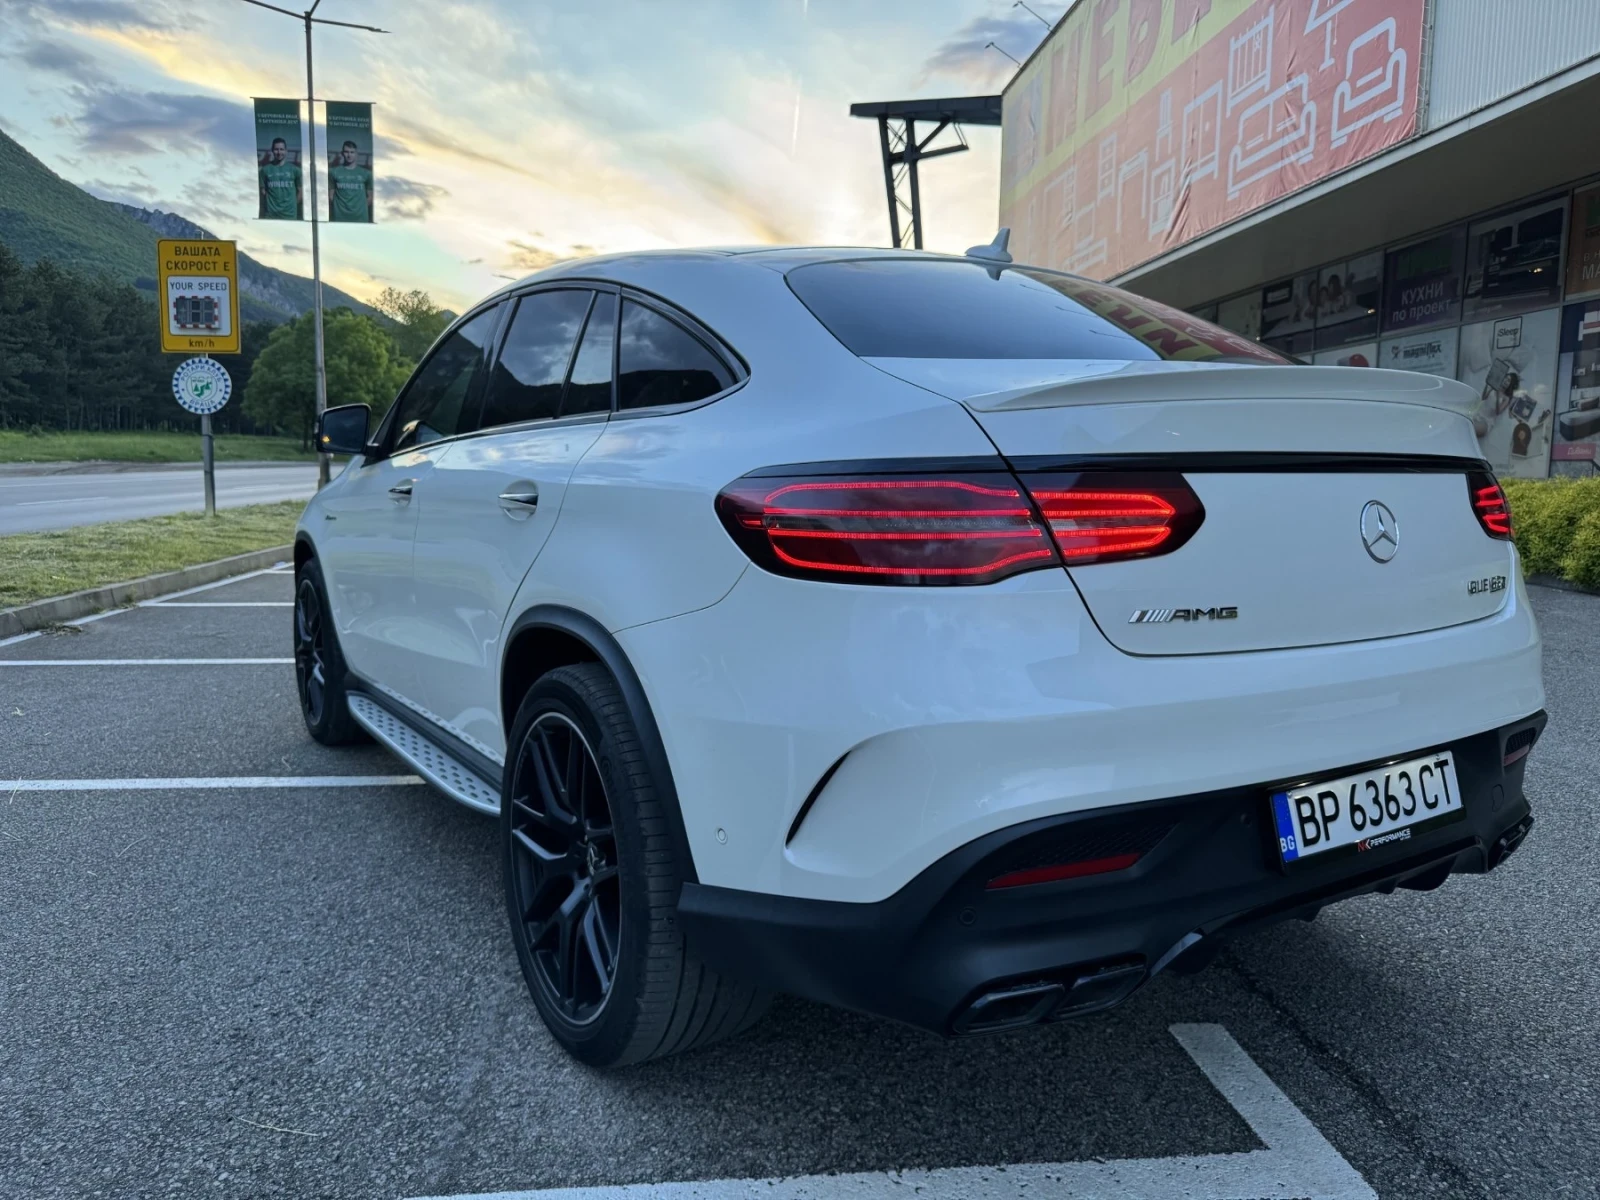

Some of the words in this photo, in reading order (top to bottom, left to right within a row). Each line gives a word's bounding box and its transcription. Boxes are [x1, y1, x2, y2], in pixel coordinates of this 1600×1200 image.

[1044, 0, 1212, 157] МЕБ
[174, 246, 221, 257] ВАШАТА
[166, 261, 218, 271] СКОРОСТ
[223, 261, 230, 271] Е
[170, 282, 193, 290] YOUR
[198, 282, 227, 291] SPEED
[1401, 281, 1444, 306] КУХНИ
[1392, 309, 1406, 323] по
[1409, 298, 1451, 321] проект
[189, 338, 215, 348] km/h
[1403, 342, 1442, 359] magniflex
[180, 365, 205, 381] РОТАРИ
[207, 366, 222, 382] КЛУБ
[190, 399, 215, 408] ВРАЦА
[1170, 606, 1238, 622] AMG
[1350, 770, 1417, 832] 6363
[1279, 836, 1296, 853] BG
[1370, 828, 1411, 847] PERFORMANCE
